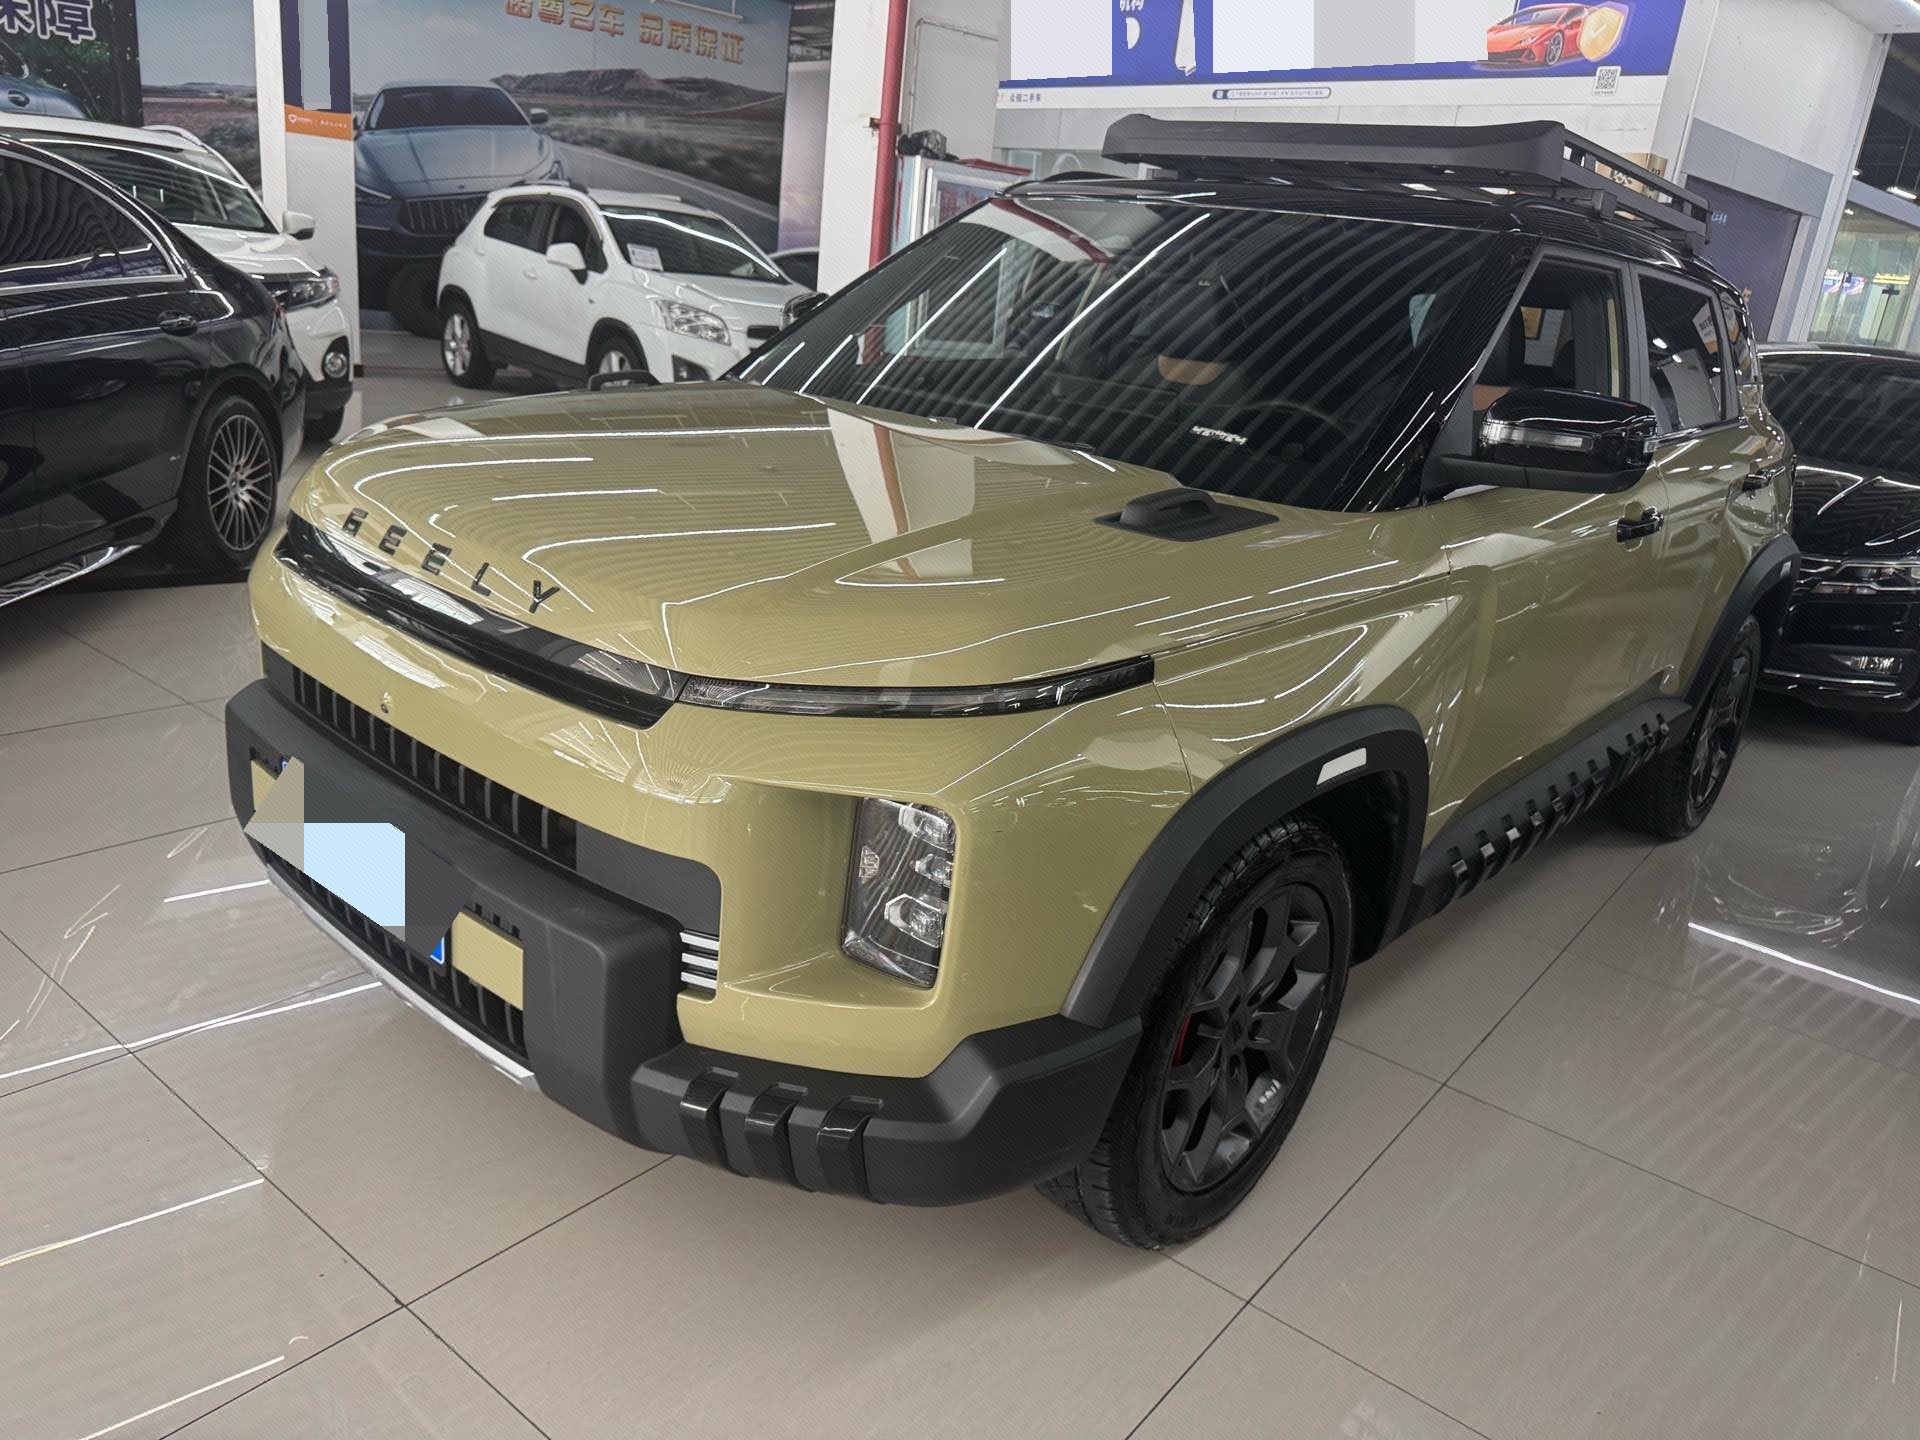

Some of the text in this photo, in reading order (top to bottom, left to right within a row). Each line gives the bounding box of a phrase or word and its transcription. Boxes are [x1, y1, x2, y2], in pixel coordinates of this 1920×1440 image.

[640, 12, 745, 65] 品质保证
[342, 507, 561, 614] GEELY
